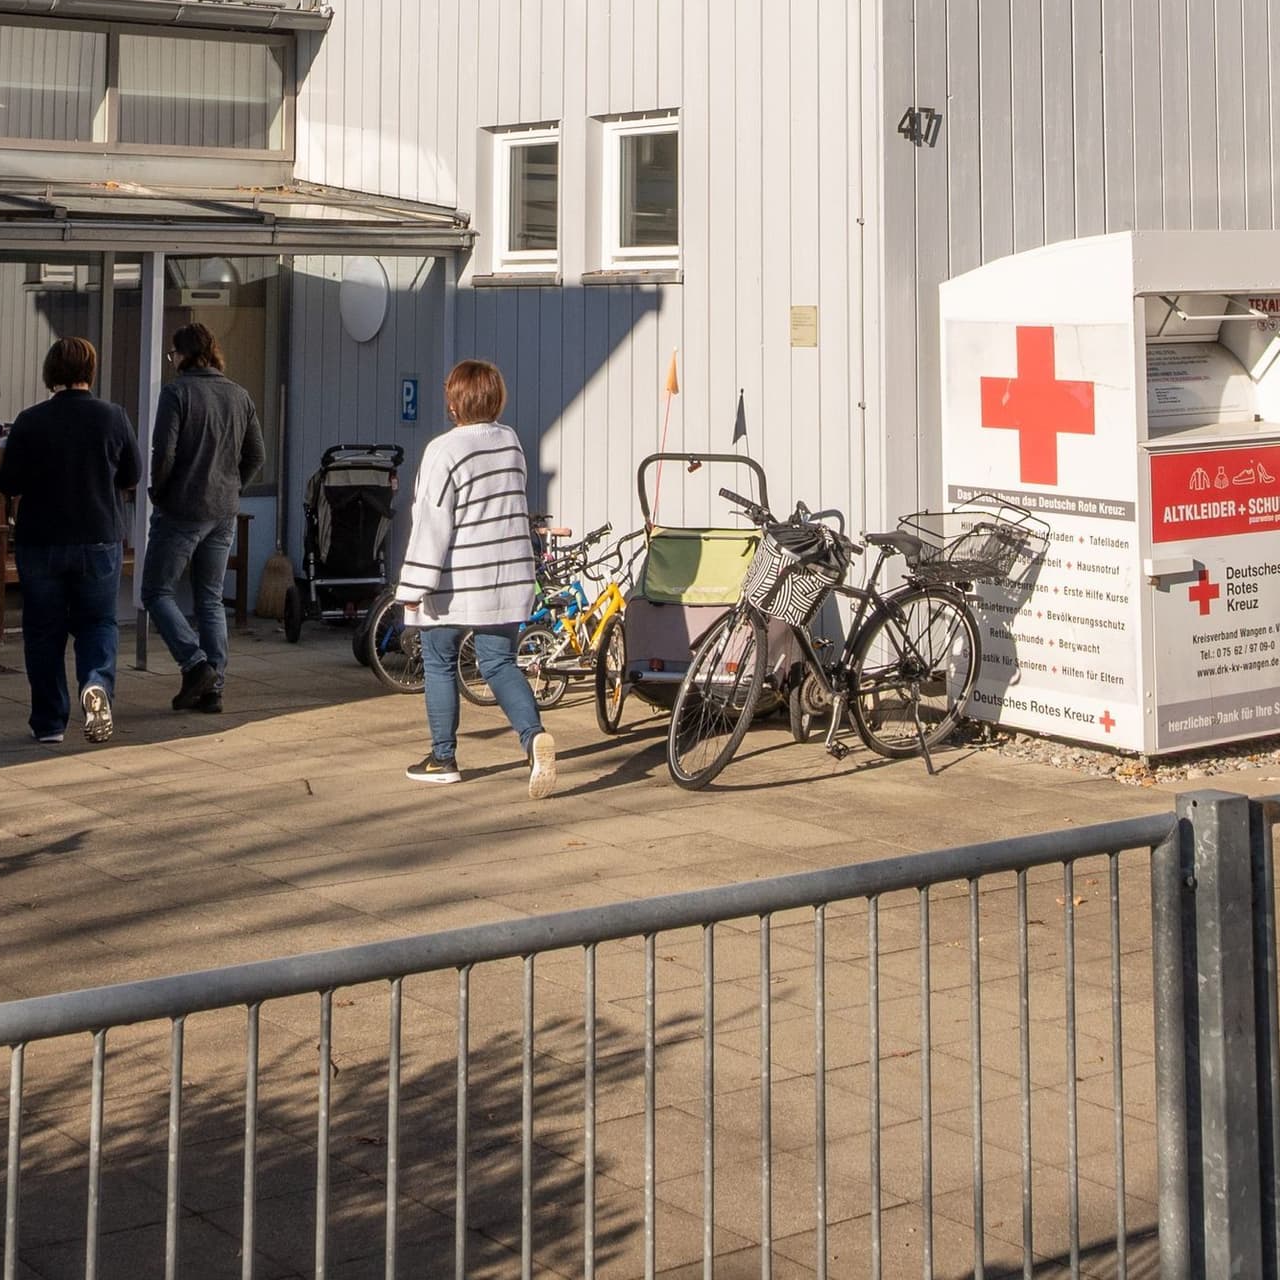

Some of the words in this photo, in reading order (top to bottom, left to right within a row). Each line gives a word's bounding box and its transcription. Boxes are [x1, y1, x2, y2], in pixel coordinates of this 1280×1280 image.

[897, 106, 936, 143] 47
[403, 381, 414, 414] P
[957, 489, 970, 500] Das
[1022, 496, 1037, 506] das
[1039, 497, 1076, 511] Deutsche
[1078, 501, 1097, 513] Rote
[1099, 503, 1126, 516] Kreuz:
[1163, 500, 1236, 524] ALTKLEIDER
[1089, 535, 1129, 549] Tafelladen
[1077, 561, 1120, 575] Hausnotruf
[1063, 586, 1084, 598] Erste
[1085, 589, 1104, 601] Hilfe
[1106, 592, 1129, 604] Kurse
[1226, 582, 1259, 596] Rotes
[1227, 598, 1259, 612] Kreuz
[1047, 610, 1126, 631] Bevölkerungsschutz
[1192, 630, 1238, 644] Kreisverband
[1240, 626, 1267, 638] Wangen
[1058, 638, 1101, 654] Bergwacht
[1234, 645, 1243, 655] 62
[1249, 643, 1258, 653] 97
[1002, 655, 1013, 666] für
[1014, 658, 1048, 672] Senioren
[1061, 665, 1085, 678] Hilfen
[1087, 670, 1098, 681] für
[1100, 672, 1124, 685] Eltern
[1197, 658, 1279, 677] www.drk-kv-wangen.de
[973, 690, 1028, 711] Deutsches
[1030, 701, 1061, 718] Rotes
[1063, 706, 1095, 724] Kreuz
[1241, 707, 1253, 720] für
[1255, 705, 1272, 717] Ihre
